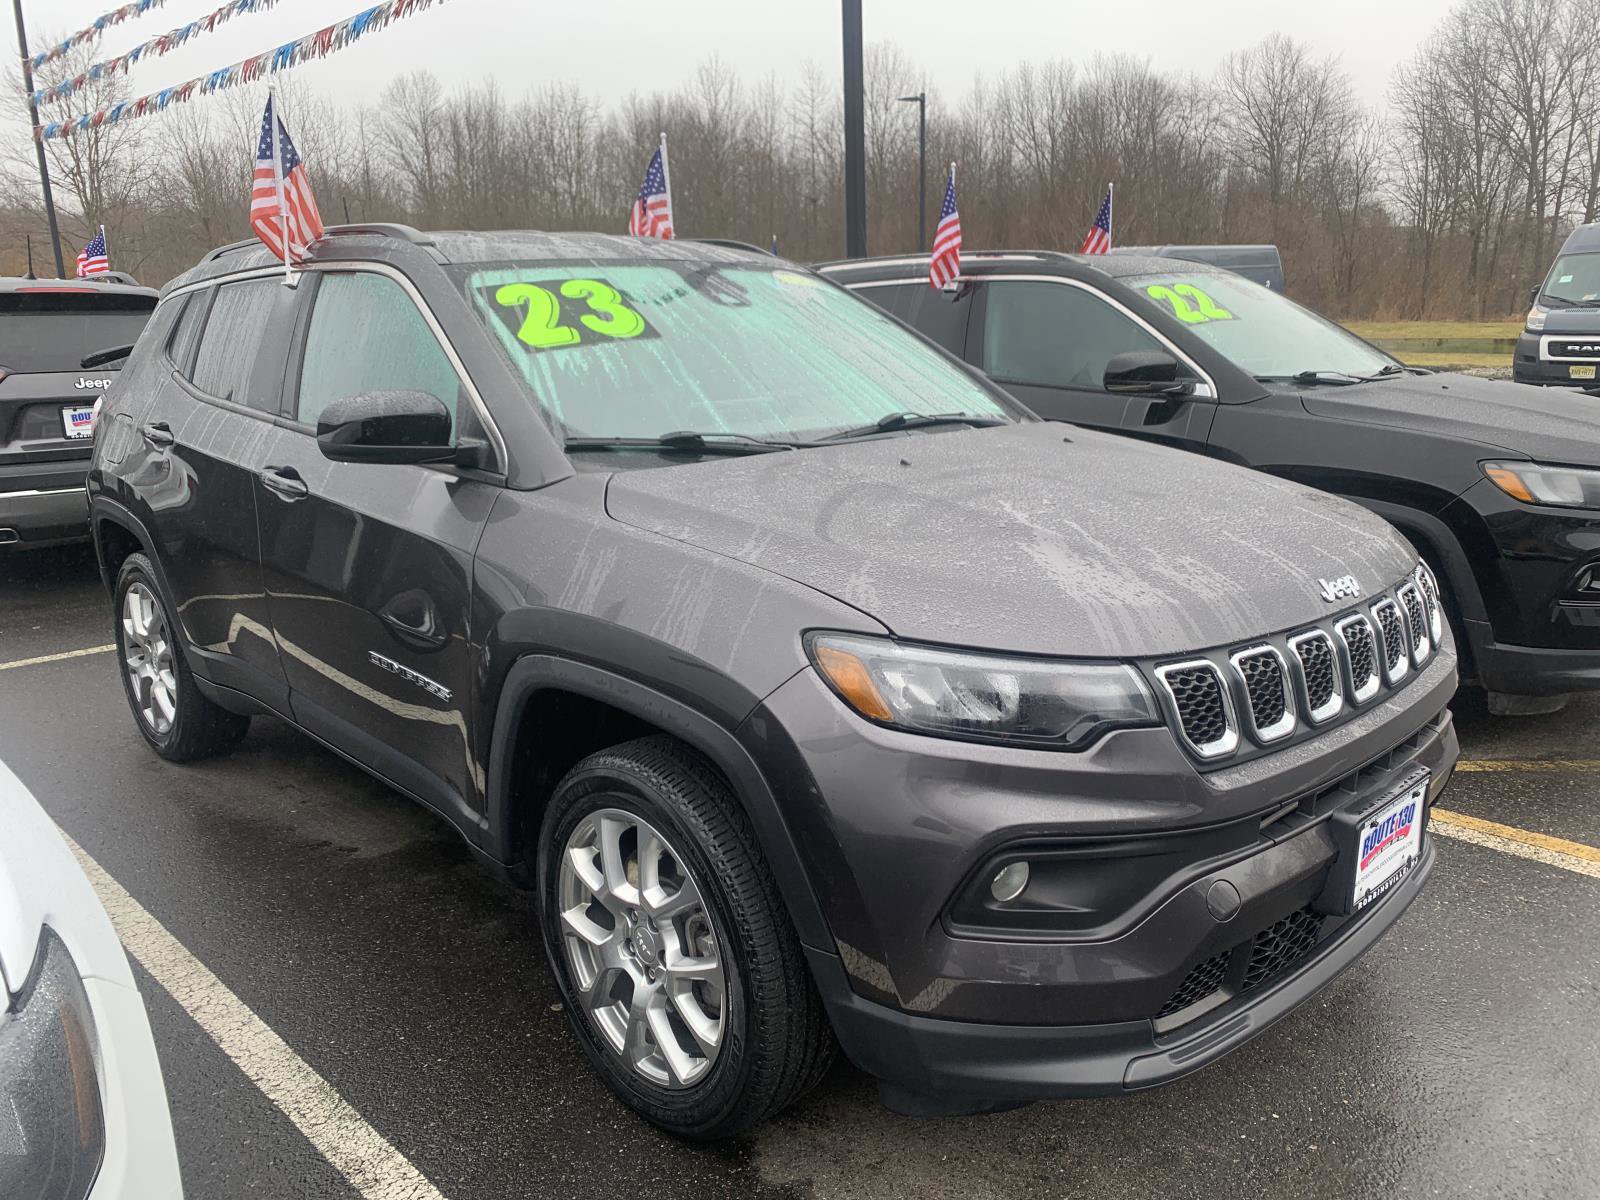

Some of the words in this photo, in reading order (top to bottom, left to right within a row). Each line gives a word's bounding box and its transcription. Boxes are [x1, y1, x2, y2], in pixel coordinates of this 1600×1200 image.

[495, 279, 645, 348] 23
[1146, 283, 1233, 324] 22
[74, 377, 112, 390] Jeep
[71, 411, 93, 422] ROU
[1318, 575, 1360, 603] Jeep
[1362, 815, 1396, 858] ROUTE
[1397, 803, 1416, 828] 130
